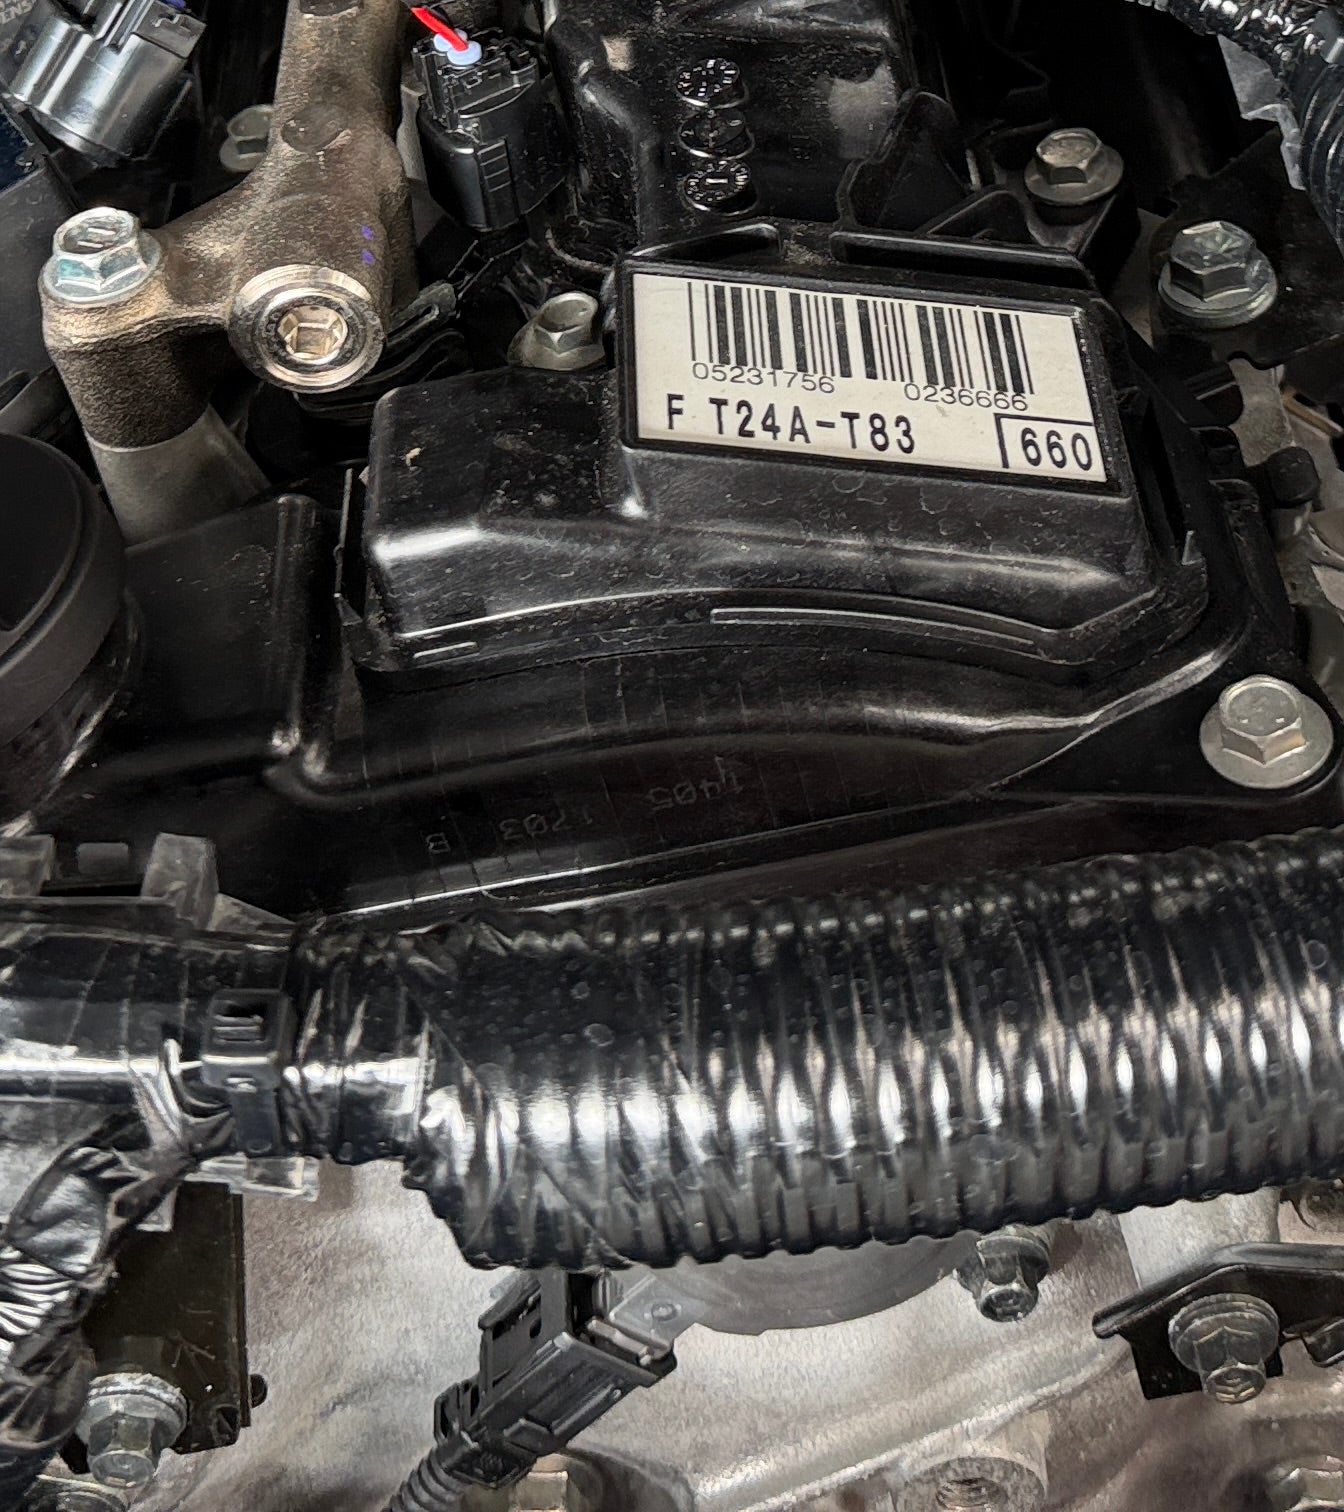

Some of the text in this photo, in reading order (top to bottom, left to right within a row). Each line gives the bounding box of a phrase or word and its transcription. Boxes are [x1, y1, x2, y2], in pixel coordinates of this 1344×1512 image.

[691, 361, 1030, 412] 05231756 0236666
[666, 392, 1094, 471] F T24A-T83 660
